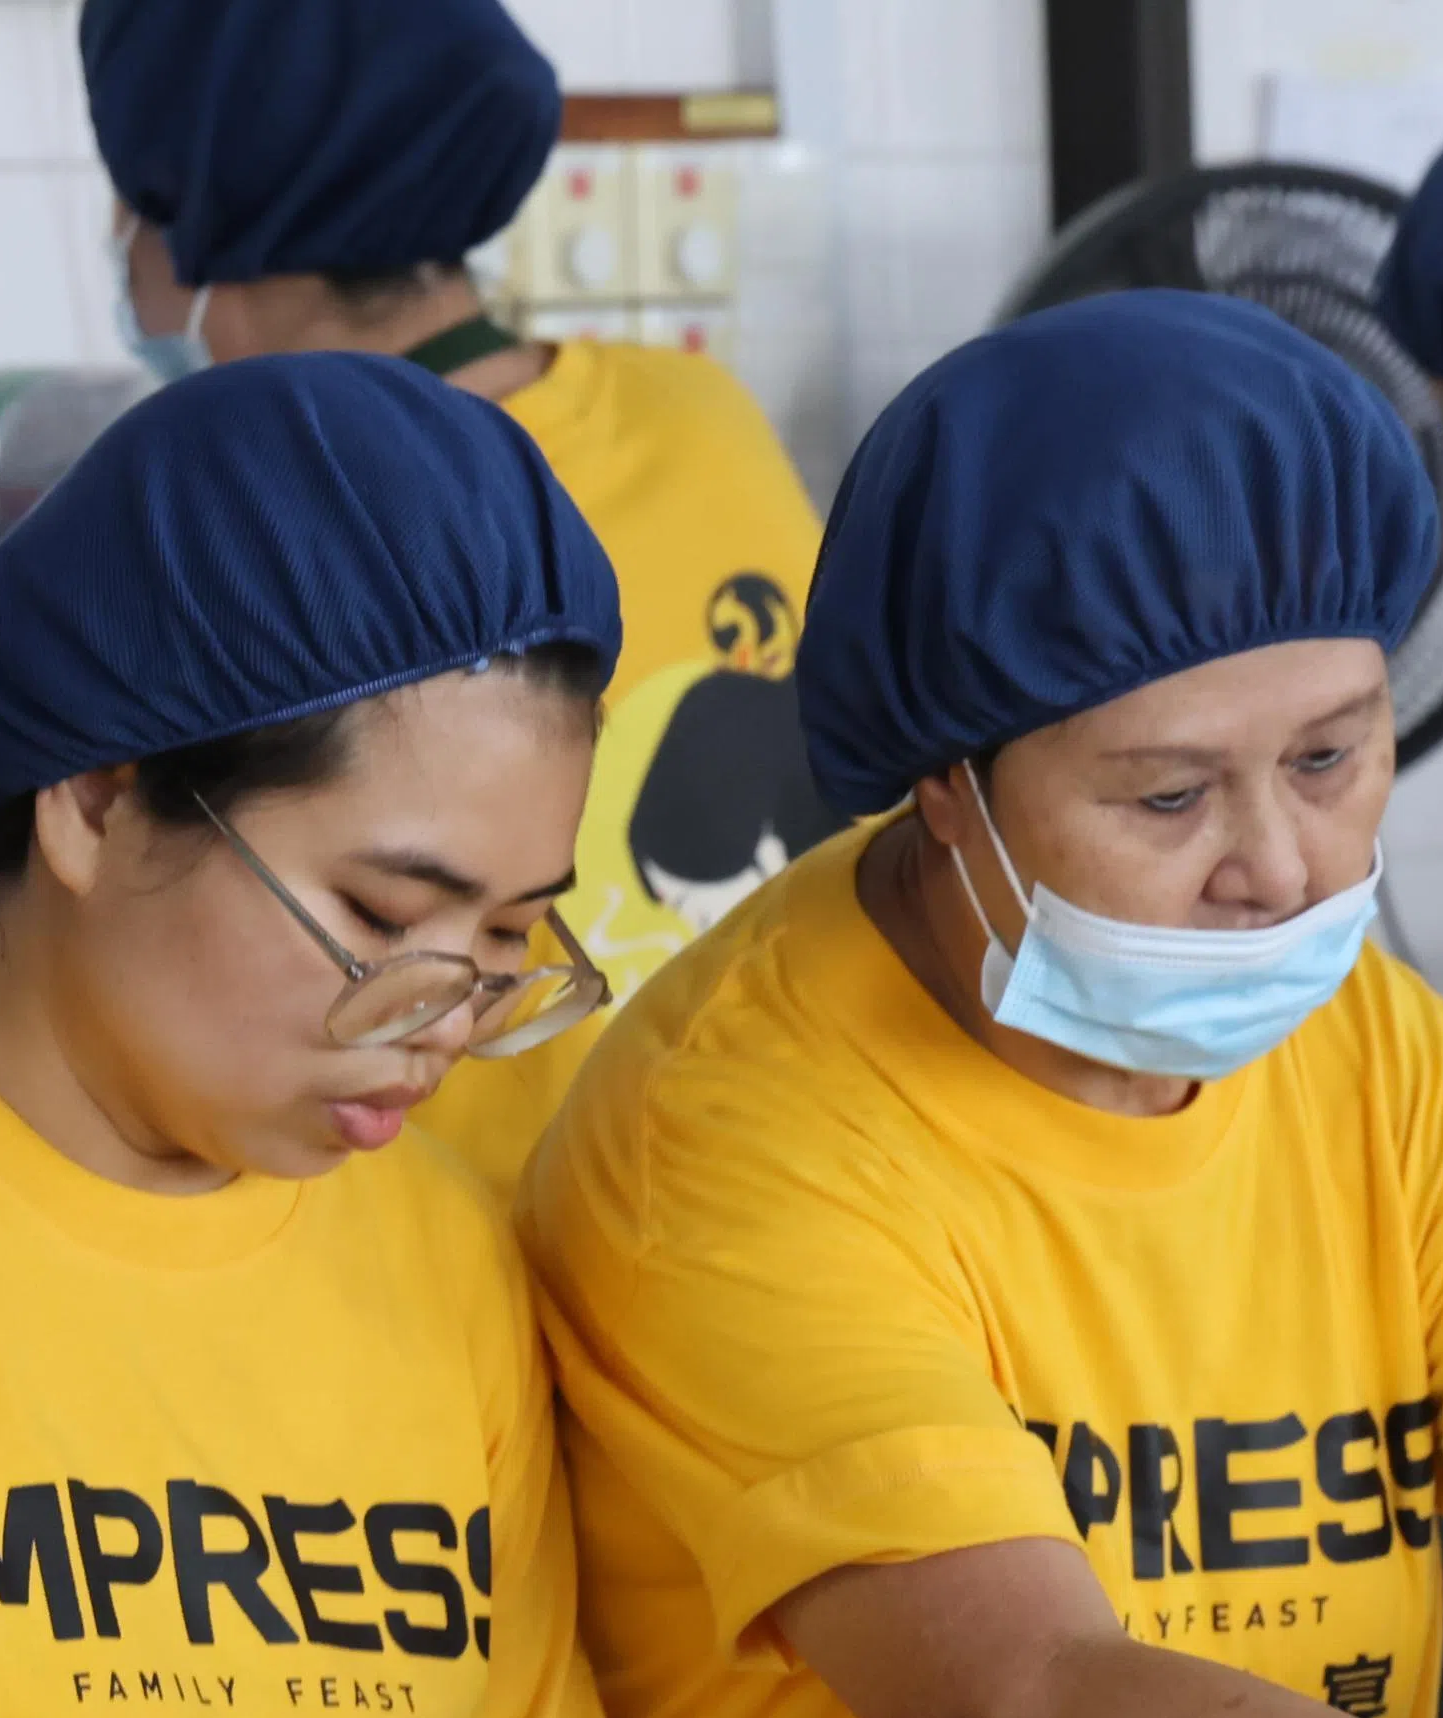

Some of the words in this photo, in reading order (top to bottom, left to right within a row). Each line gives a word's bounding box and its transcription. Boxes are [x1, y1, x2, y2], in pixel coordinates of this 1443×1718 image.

[1011, 1395, 1438, 1580] PRESS
[1183, 1596, 1331, 1634] FEAST
[73, 1670, 235, 1706] FAMILY
[286, 1677, 415, 1713] FEAST
